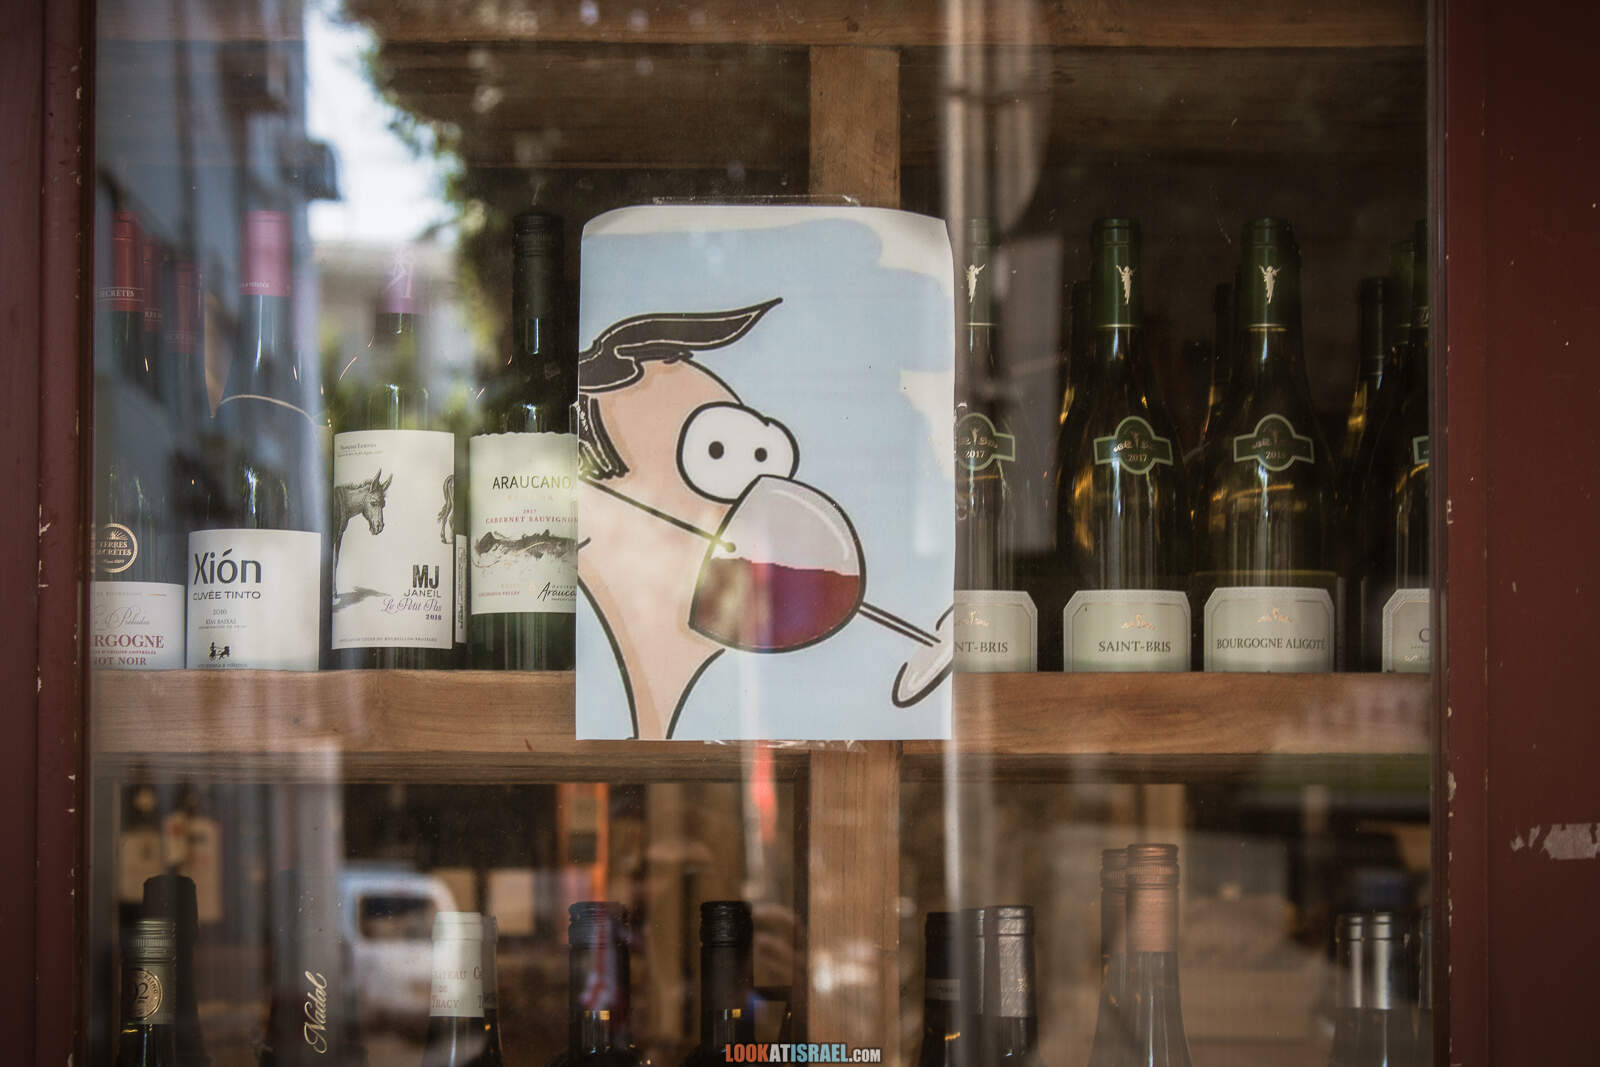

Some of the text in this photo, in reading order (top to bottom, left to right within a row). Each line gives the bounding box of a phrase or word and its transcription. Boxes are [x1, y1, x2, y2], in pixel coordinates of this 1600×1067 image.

[966, 450, 985, 458] 2017
[1127, 454, 1149, 462] 2017
[492, 475, 572, 490] ARAUCANO
[194, 548, 262, 585] Xión
[412, 564, 440, 589] MJ
[193, 590, 261, 601] CUVÉE TINTO
[403, 589, 442, 598] JANEIL
[1098, 640, 1172, 654] SAINT-BRIS
[1216, 637, 1283, 650] BOURGOGNE
[118, 656, 146, 666] NOIR
[304, 970, 328, 1054] Nadal
